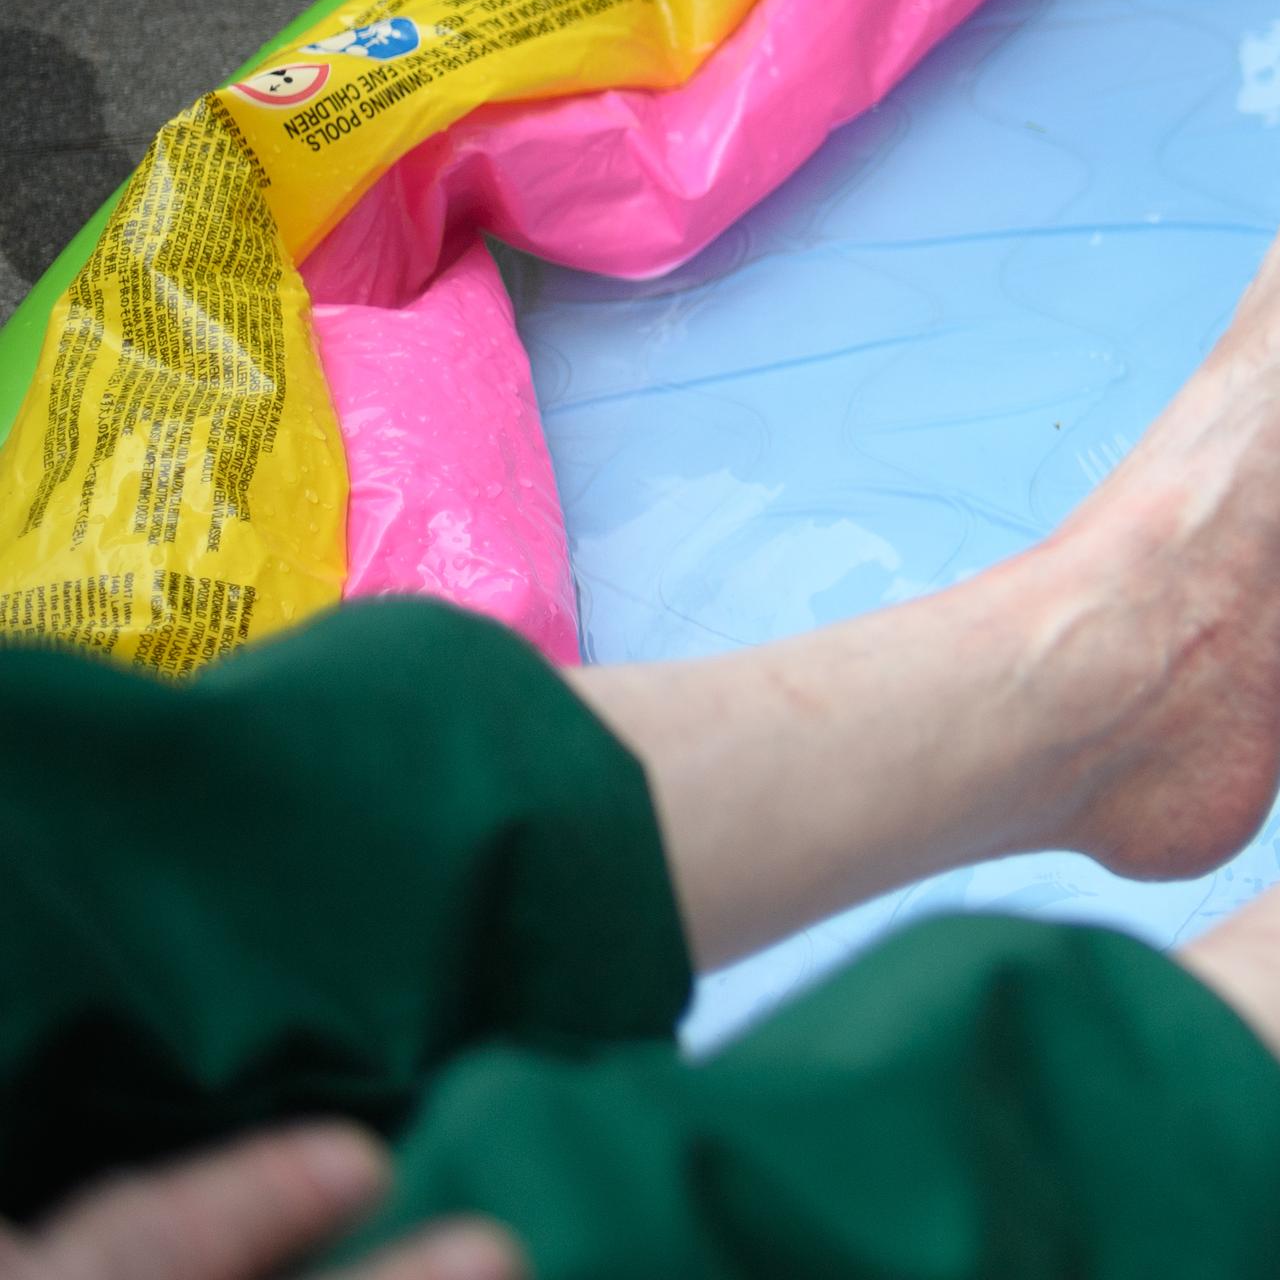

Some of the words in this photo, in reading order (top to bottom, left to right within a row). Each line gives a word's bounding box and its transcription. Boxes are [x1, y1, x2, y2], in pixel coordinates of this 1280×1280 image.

[357, 65, 433, 121] SWIMMING
[282, 81, 361, 140] CHILDREN
[300, 107, 362, 155] POOLS.
[155, 313, 167, 346] BRUKES
[213, 489, 226, 506] EEN
[50, 594, 59, 610] the
[87, 576, 96, 617] utilisées
[99, 574, 108, 608] Rechte
[123, 571, 134, 599] ©2017
[9, 591, 21, 628] Fuqing,
[22, 588, 34, 626] Trading
[175, 625, 189, 638] NU
[185, 621, 204, 655] OTROKA
